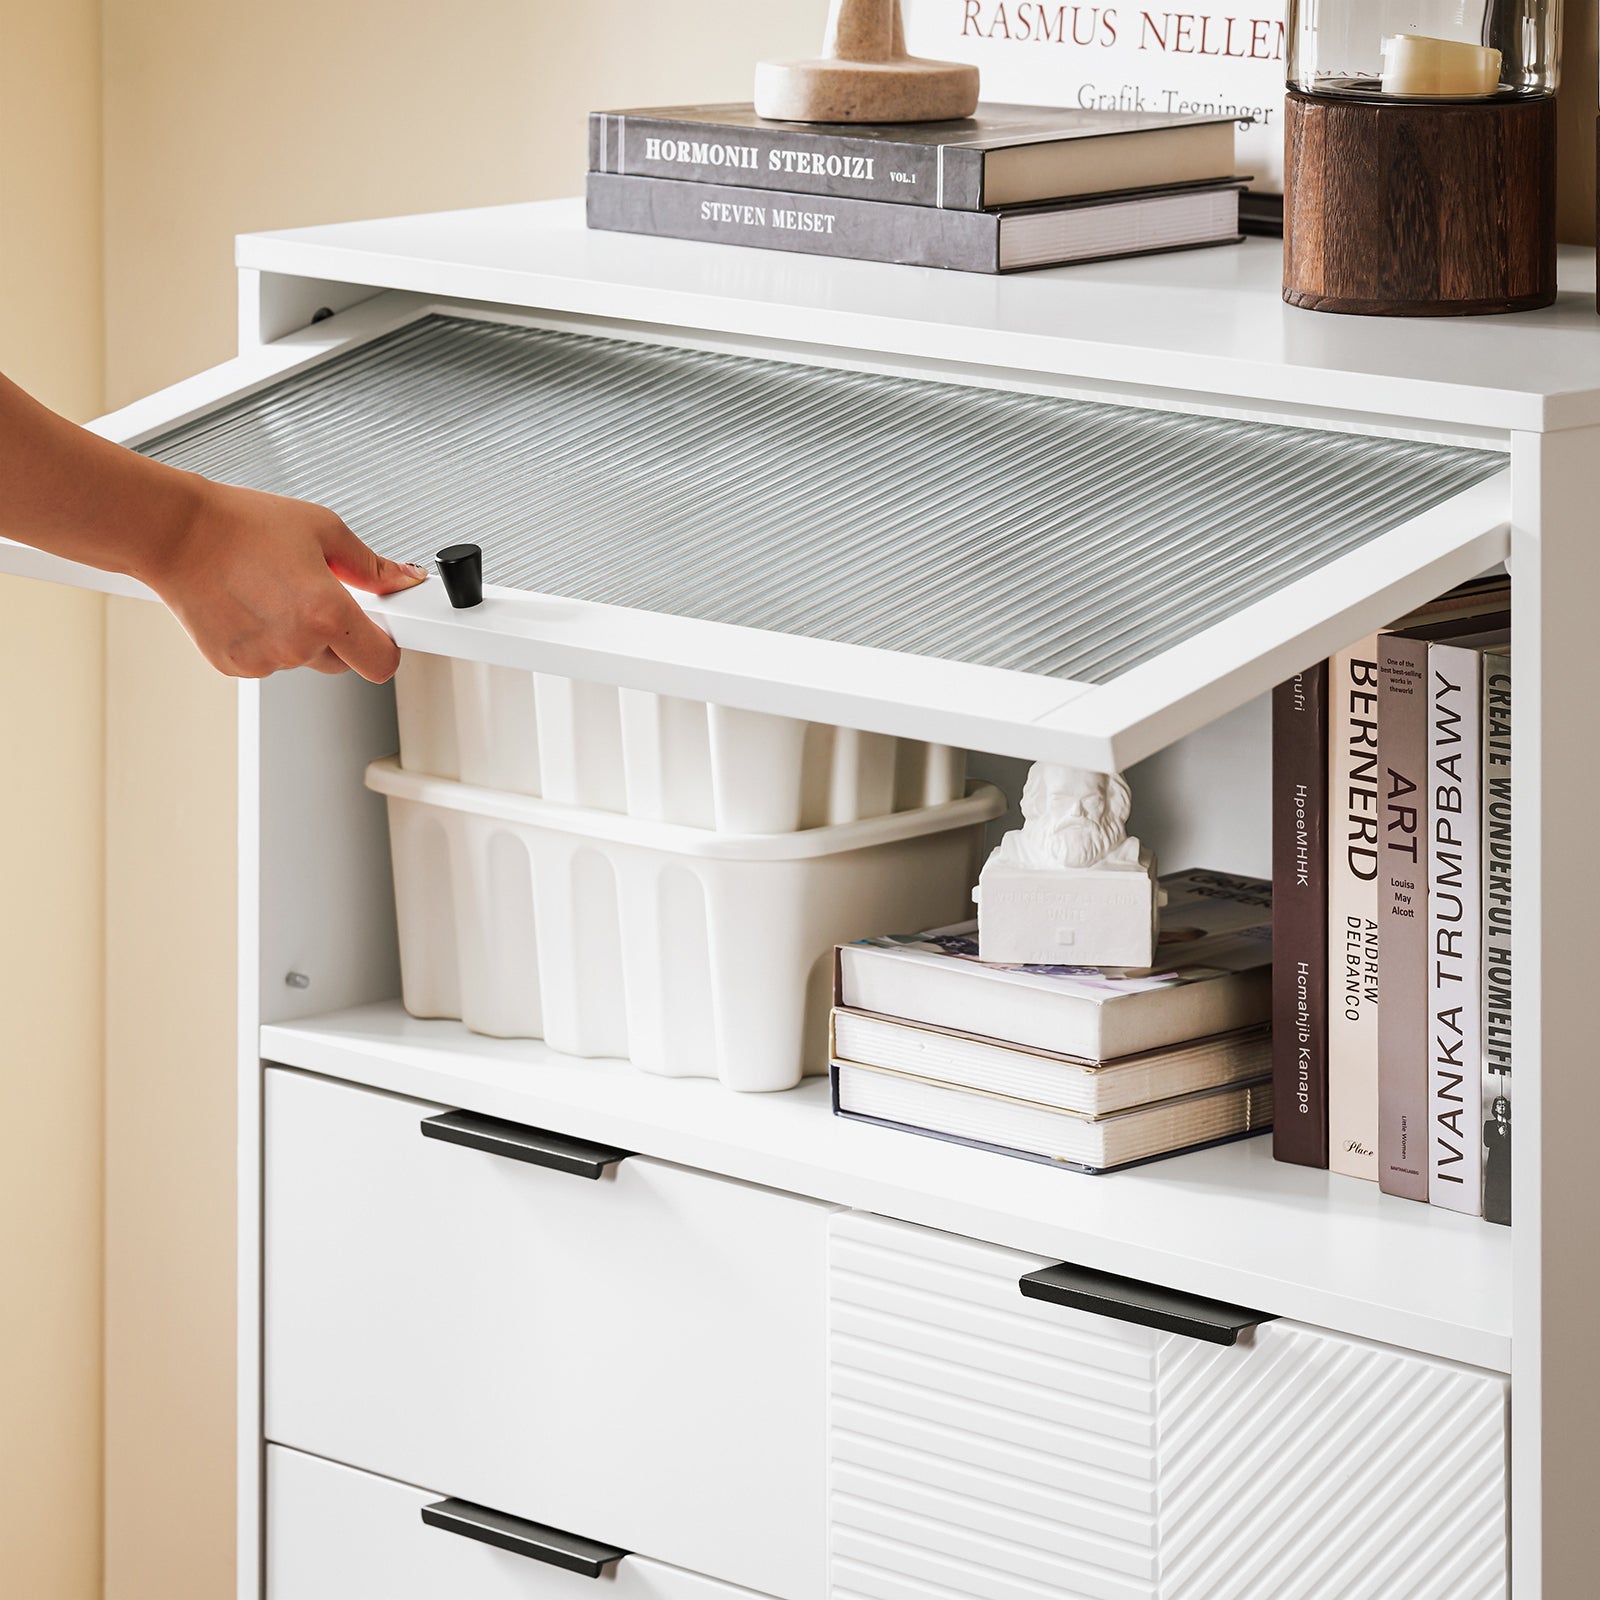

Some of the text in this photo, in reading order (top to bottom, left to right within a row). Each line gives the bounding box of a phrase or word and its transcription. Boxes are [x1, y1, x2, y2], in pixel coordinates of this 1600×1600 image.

[960, 0, 1117, 48] RASMUS
[1077, 84, 1146, 112] Grafik
[645, 138, 917, 184] HORMONII STEROIZI VOL.1
[701, 201, 835, 234] STEVEN MEISET
[1387, 658, 1398, 666] One
[1348, 658, 1378, 881] BERNERD
[1387, 767, 1417, 864] ART
[1391, 878, 1415, 889] Louisa
[1394, 892, 1412, 905] May
[1488, 674, 1511, 1078] CREATE WONDERFUL HOMELIFE
[1391, 906, 1414, 918] Alcott
[1436, 671, 1464, 1184] IVANKA TRUMPBAWY
[1345, 916, 1361, 1022] DELBANCO
[1364, 918, 1379, 1005] ANDREW
[1296, 1047, 1311, 1114] Kanape
